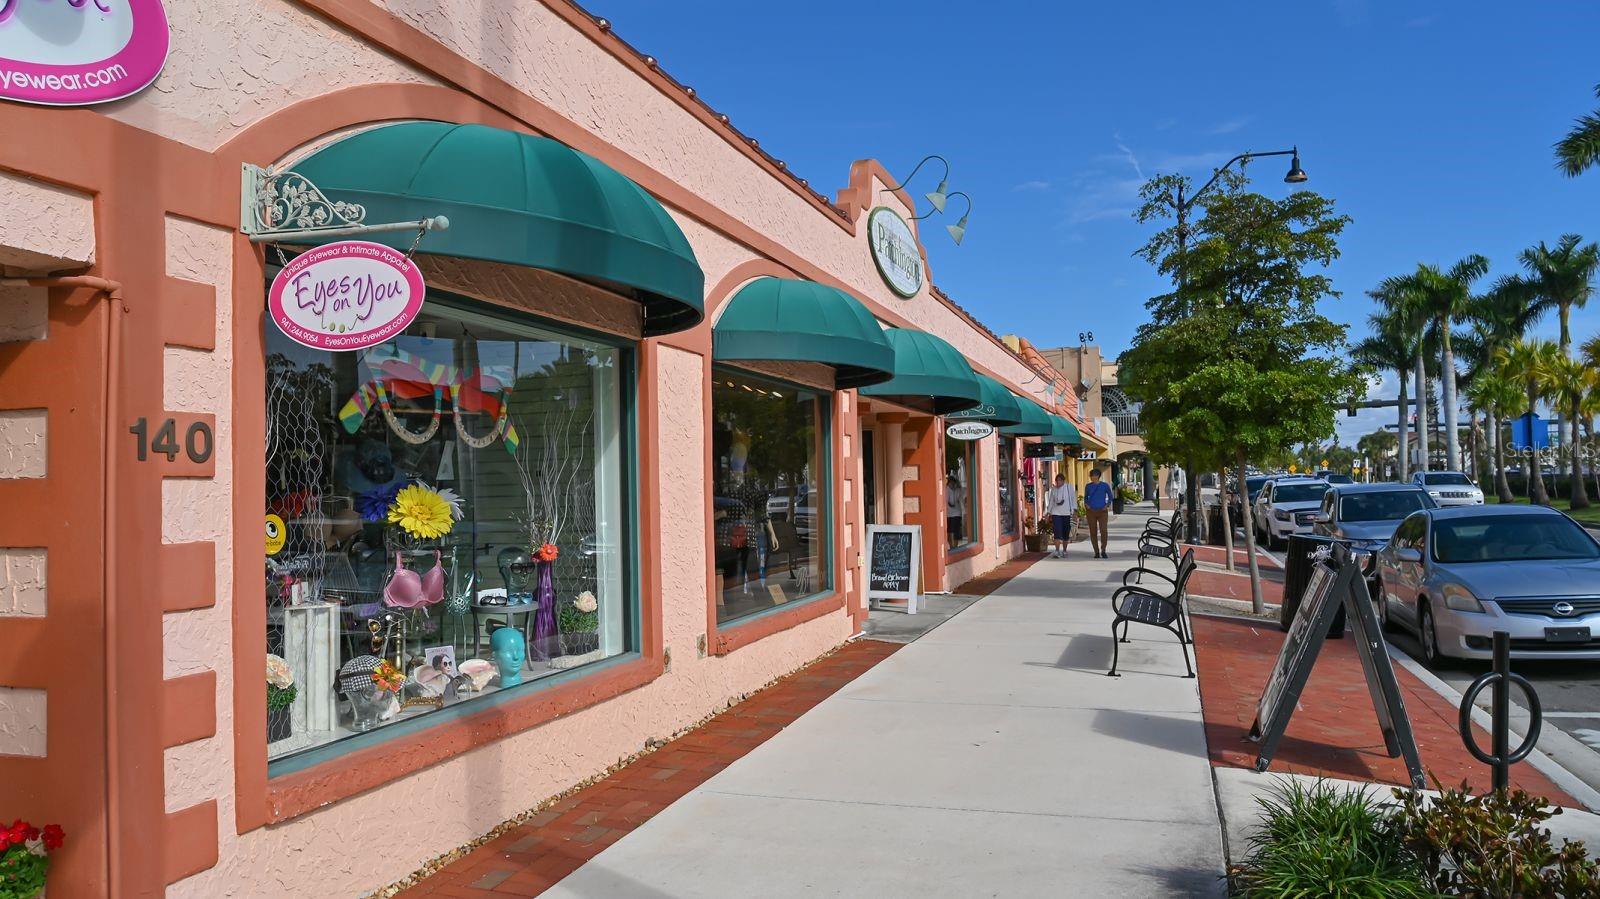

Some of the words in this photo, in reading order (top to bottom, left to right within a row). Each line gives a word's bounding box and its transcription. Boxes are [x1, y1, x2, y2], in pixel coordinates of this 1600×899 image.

[283, 259, 309, 279] Unique
[309, 247, 341, 262] Eyewear
[341, 245, 348, 254] &
[349, 246, 380, 256] Intimate
[380, 251, 411, 272] Apparel
[292, 270, 350, 316] Eyes
[333, 298, 351, 312] on
[353, 274, 402, 321] You
[280, 317, 319, 343] 941.244.9054
[324, 313, 408, 347] EyesOnYouEyewear.com
[129, 417, 213, 464] 140
